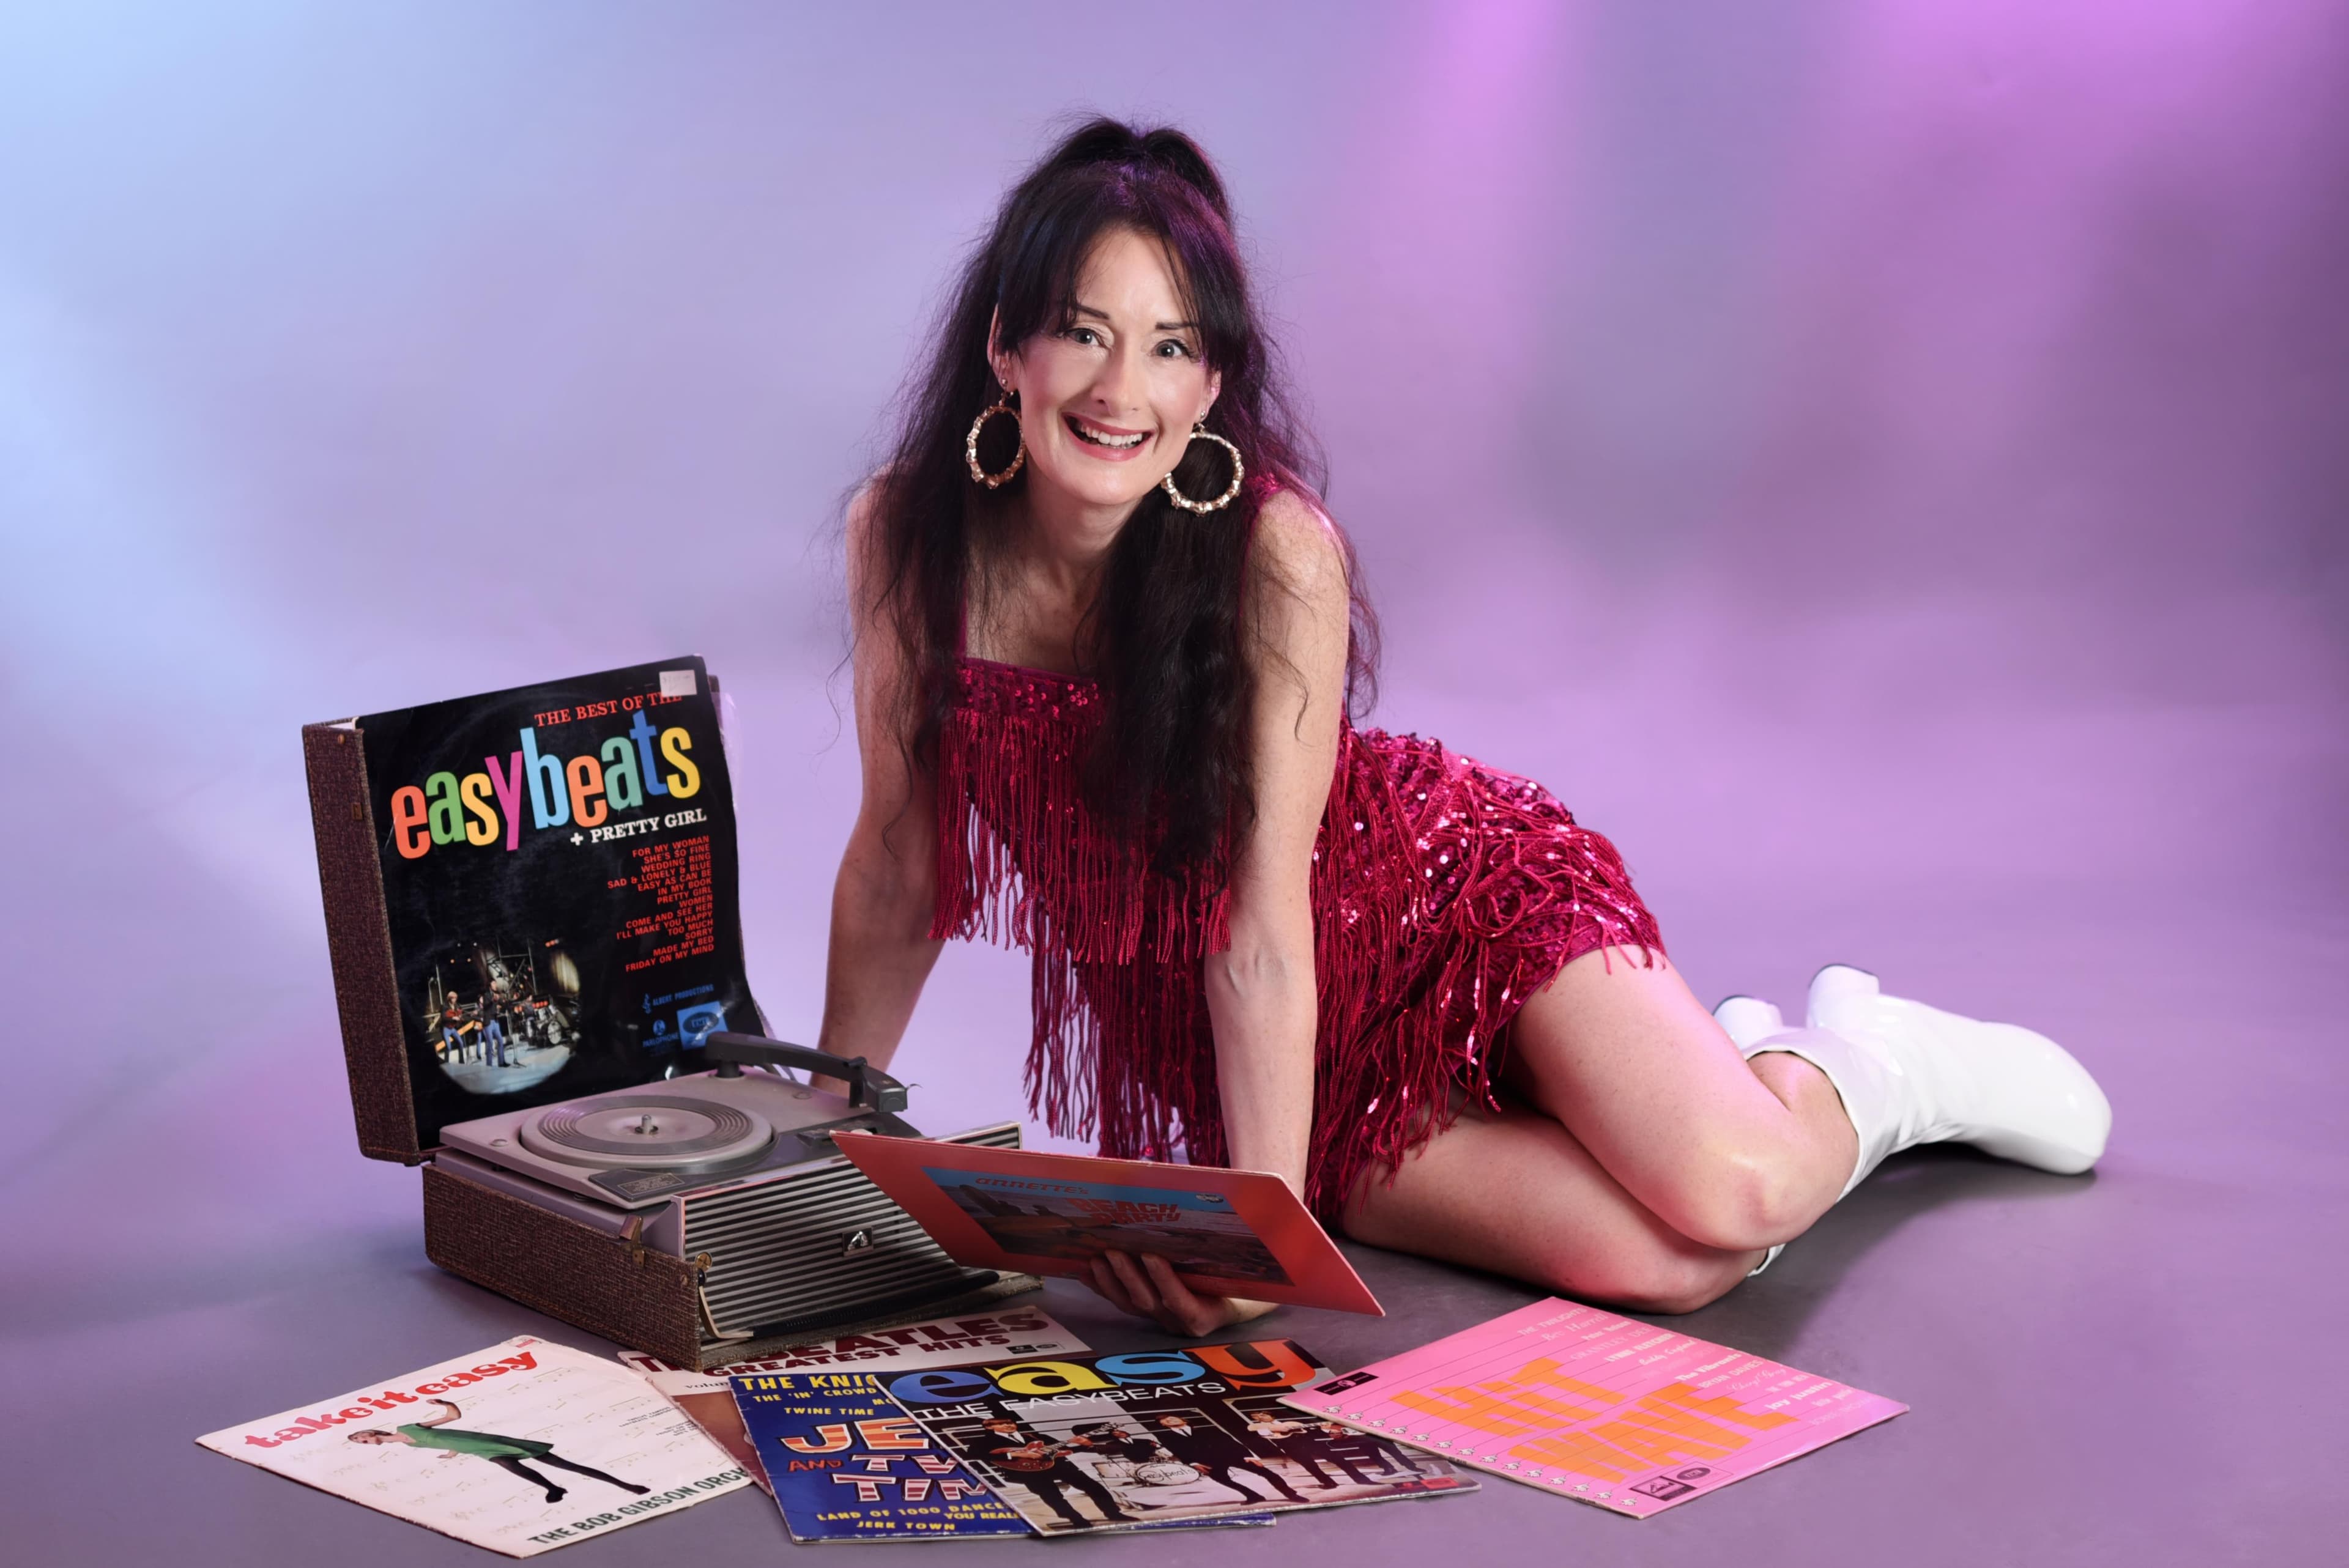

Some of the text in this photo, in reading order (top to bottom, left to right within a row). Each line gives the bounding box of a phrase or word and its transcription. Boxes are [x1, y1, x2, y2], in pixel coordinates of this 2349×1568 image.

[534, 709, 571, 727] THE
[575, 700, 618, 720] BEST
[622, 696, 644, 711] OF
[391, 709, 700, 859] easybeats
[590, 817, 659, 843] PRETTY
[664, 808, 707, 827] GIRL
[633, 835, 710, 857] FOR MY WOMAN
[644, 843, 710, 864] SHE'S SO FINE
[641, 852, 711, 873] WEDDING RING
[607, 878, 627, 889] SAD
[642, 868, 676, 882] LONELY
[689, 860, 711, 871] BLUE
[637, 868, 711, 892] EASY AS CAN BE
[657, 887, 712, 904] PRETTY GIRL
[658, 878, 712, 895] IN MY BOOK
[679, 894, 713, 908] WOMEN
[616, 911, 713, 940] I'LL MAKE YOU HAPPY
[626, 902, 713, 929] COME AND SEE HER
[667, 919, 713, 936] TOO MUCH
[685, 927, 713, 940] SORRY
[653, 935, 714, 956] MADE MY BED
[626, 944, 714, 972] FRIDAY ON MY MIND
[653, 983, 714, 1007] ALBERT PRODUCTIONS
[642, 1032, 679, 1048] PARLOPHONE
[1067, 1197, 1179, 1213] BEACH
[1517, 1325, 1538, 1336] THE
[702, 1347, 902, 1377] GREATEST
[918, 1335, 1011, 1352] HITS
[1674, 1370, 1699, 1381] The
[1696, 1353, 1743, 1374] Vibrants
[889, 1339, 1316, 1404] easy
[1698, 1374, 1731, 1389] BRYAN
[1728, 1359, 1764, 1377] DAVIES
[738, 1376, 795, 1391] THE
[752, 1394, 782, 1403] THE
[824, 1387, 877, 1397] CROWD
[245, 1352, 538, 1448] take it easy
[912, 1381, 1227, 1420] THE EASYBEATS
[1508, 1381, 1800, 1484] WAVE
[788, 1459, 844, 1472] AND
[527, 1528, 578, 1544] THE
[571, 1512, 623, 1531] BOB
[617, 1486, 700, 1515] GIBSON
[817, 1511, 861, 1522] LAND
[869, 1509, 891, 1517] OF
[899, 1507, 940, 1516] 1000
[856, 1521, 896, 1529] JERK
